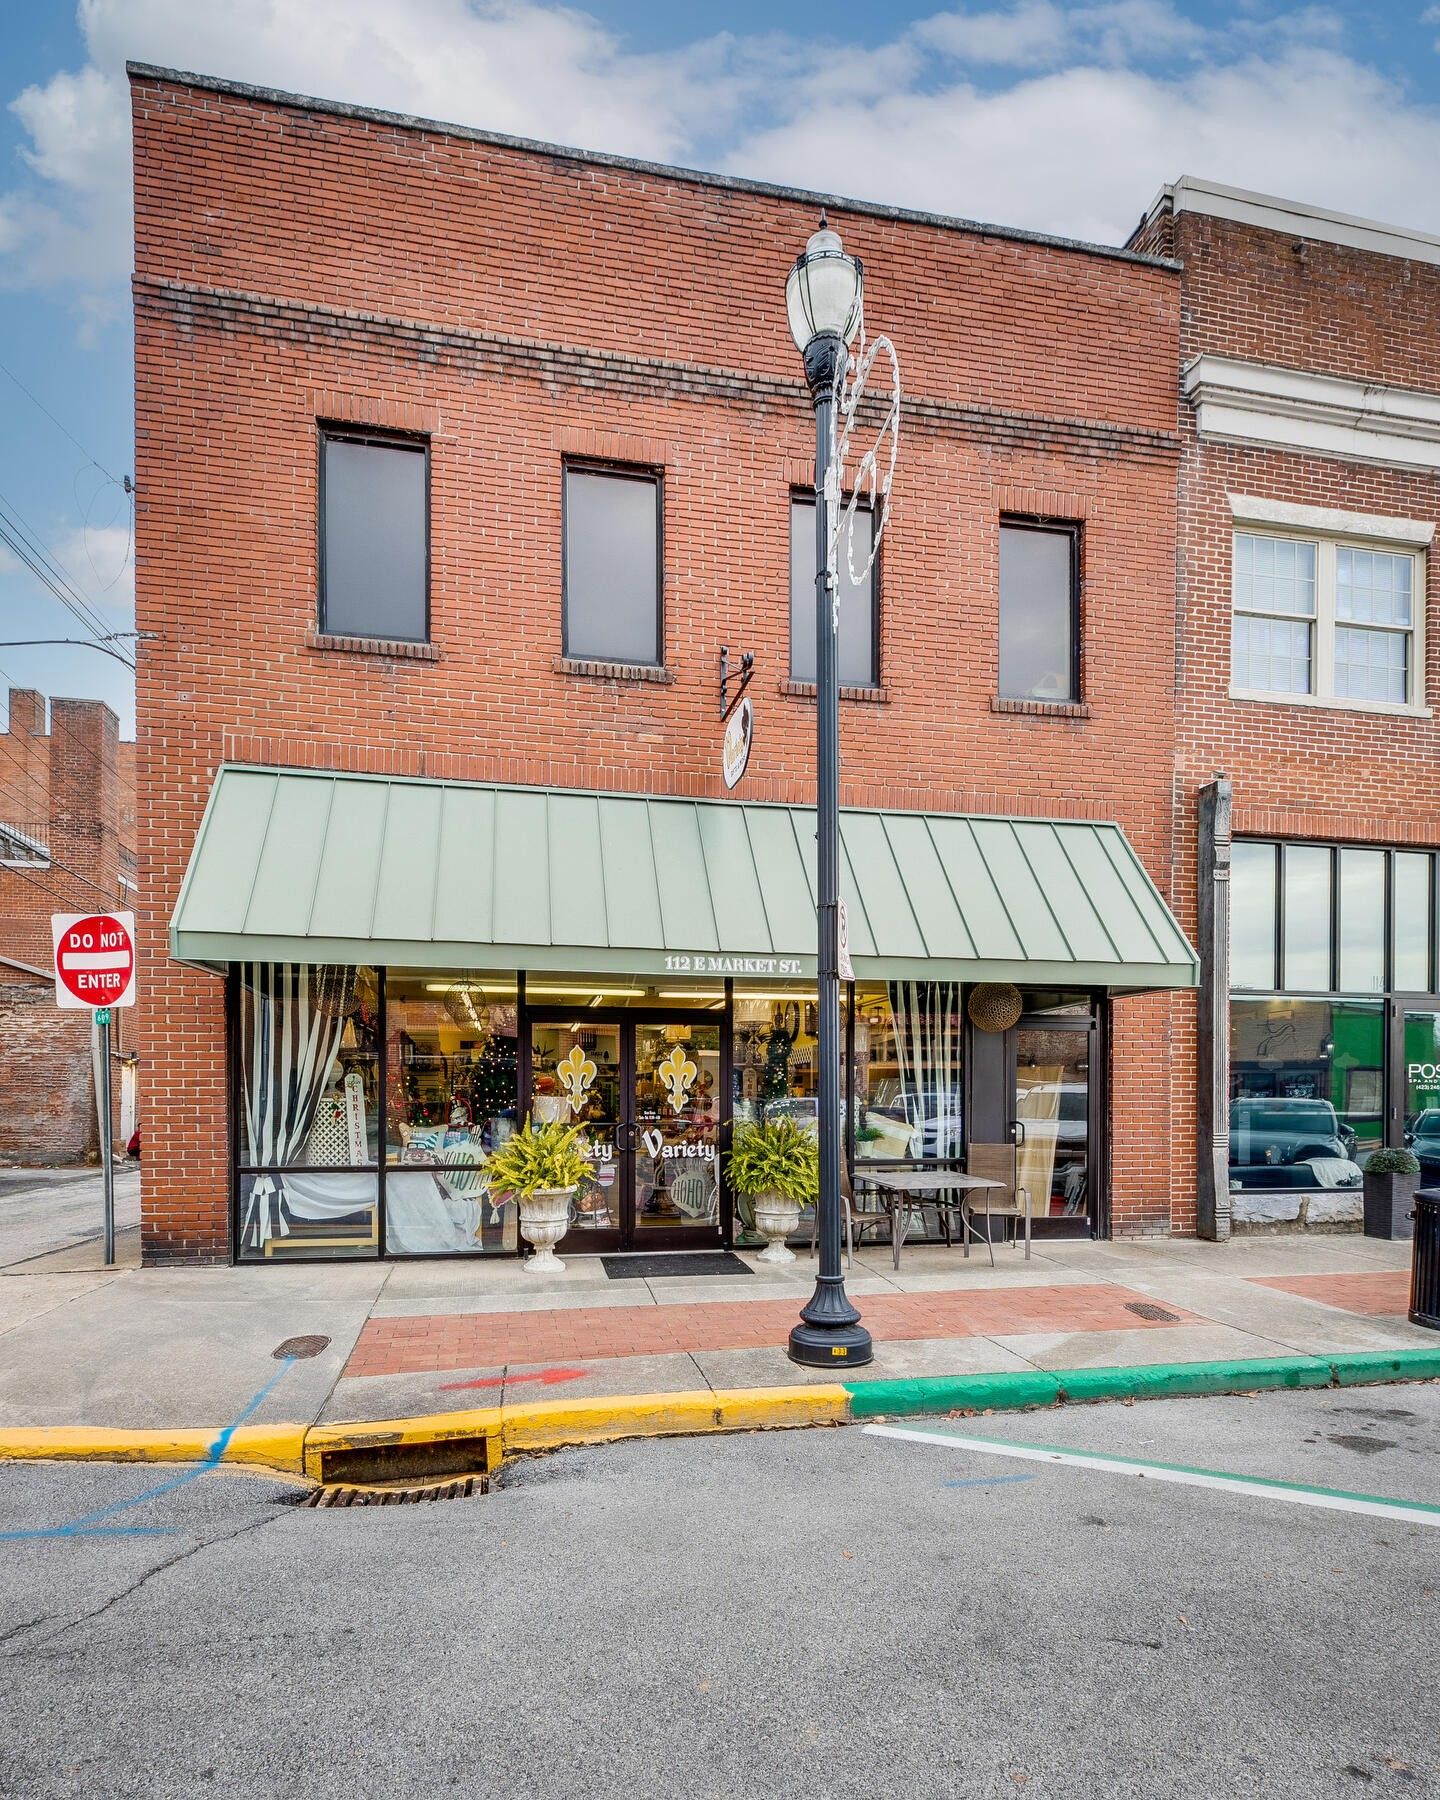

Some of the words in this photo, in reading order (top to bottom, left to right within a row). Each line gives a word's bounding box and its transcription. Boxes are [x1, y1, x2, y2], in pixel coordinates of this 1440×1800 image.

[69, 933, 94, 949] DO
[100, 931, 124, 948] NOT
[664, 955, 691, 970] 112
[692, 956, 706, 971] E
[707, 957, 777, 973] MARKET
[779, 959, 802, 974] ST.
[77, 973, 121, 989] ENTER
[641, 1128, 716, 1162] Variety
